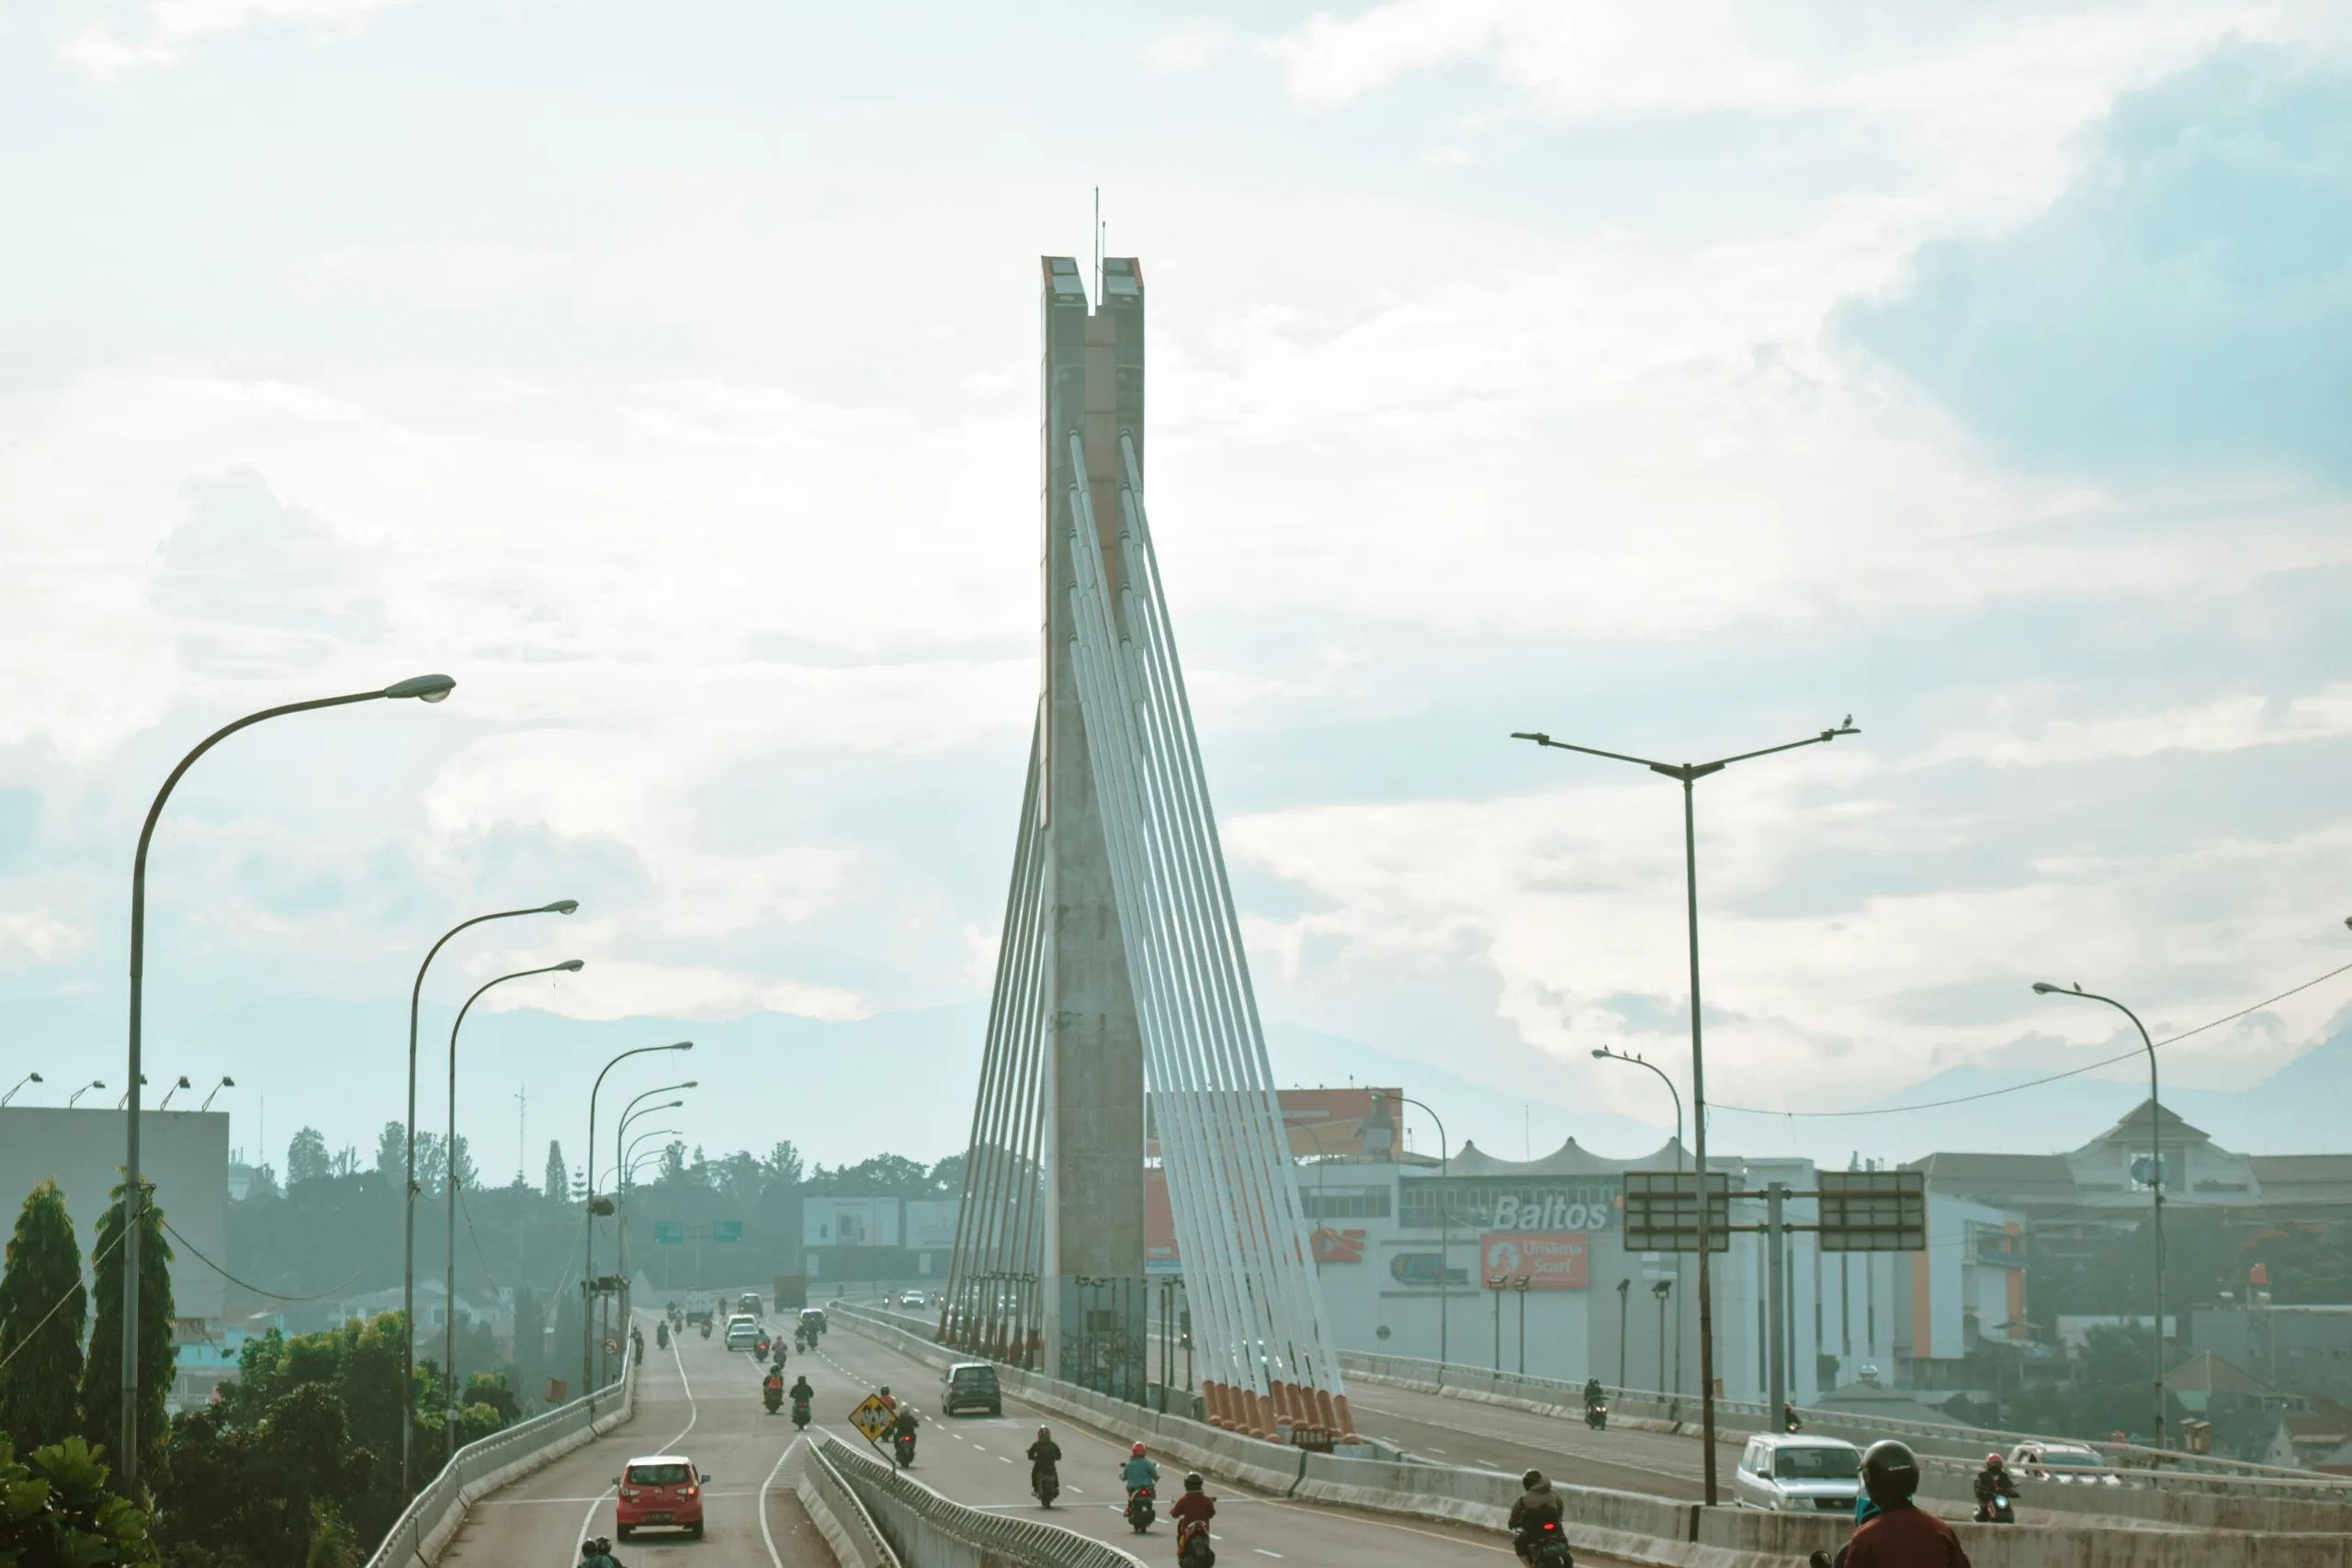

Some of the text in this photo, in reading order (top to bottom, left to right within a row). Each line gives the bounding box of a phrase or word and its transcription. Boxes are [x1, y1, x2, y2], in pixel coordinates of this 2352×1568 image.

[1493, 1194, 1608, 1231] Baltos
[1522, 1241, 1582, 1256] Umama
[1532, 1258, 1572, 1275] Scarf
